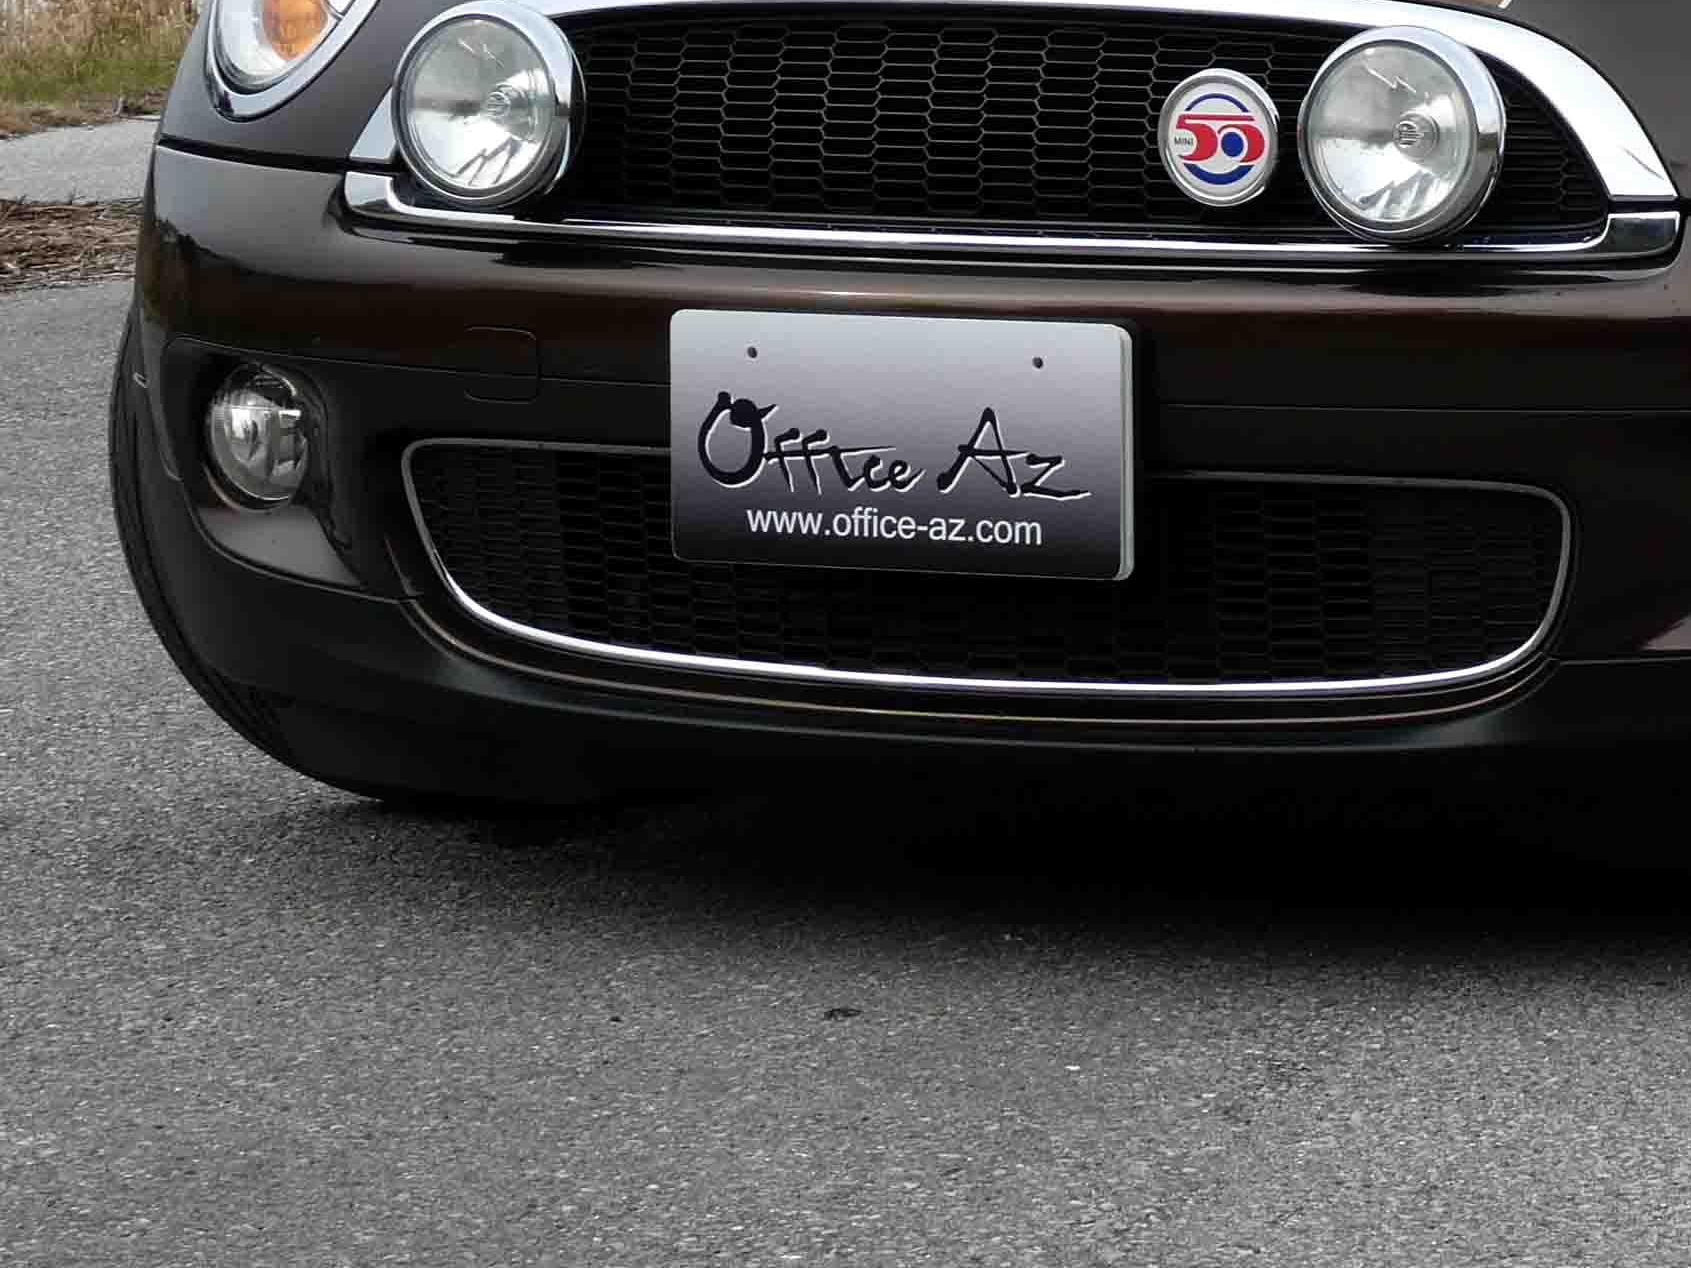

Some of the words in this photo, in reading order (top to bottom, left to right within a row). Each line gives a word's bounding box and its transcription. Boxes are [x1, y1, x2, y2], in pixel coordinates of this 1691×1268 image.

[1175, 113, 1265, 163] 50
[698, 390, 926, 494] Office
[936, 406, 1092, 500] Az
[746, 506, 1043, 547] www.office-az.com
